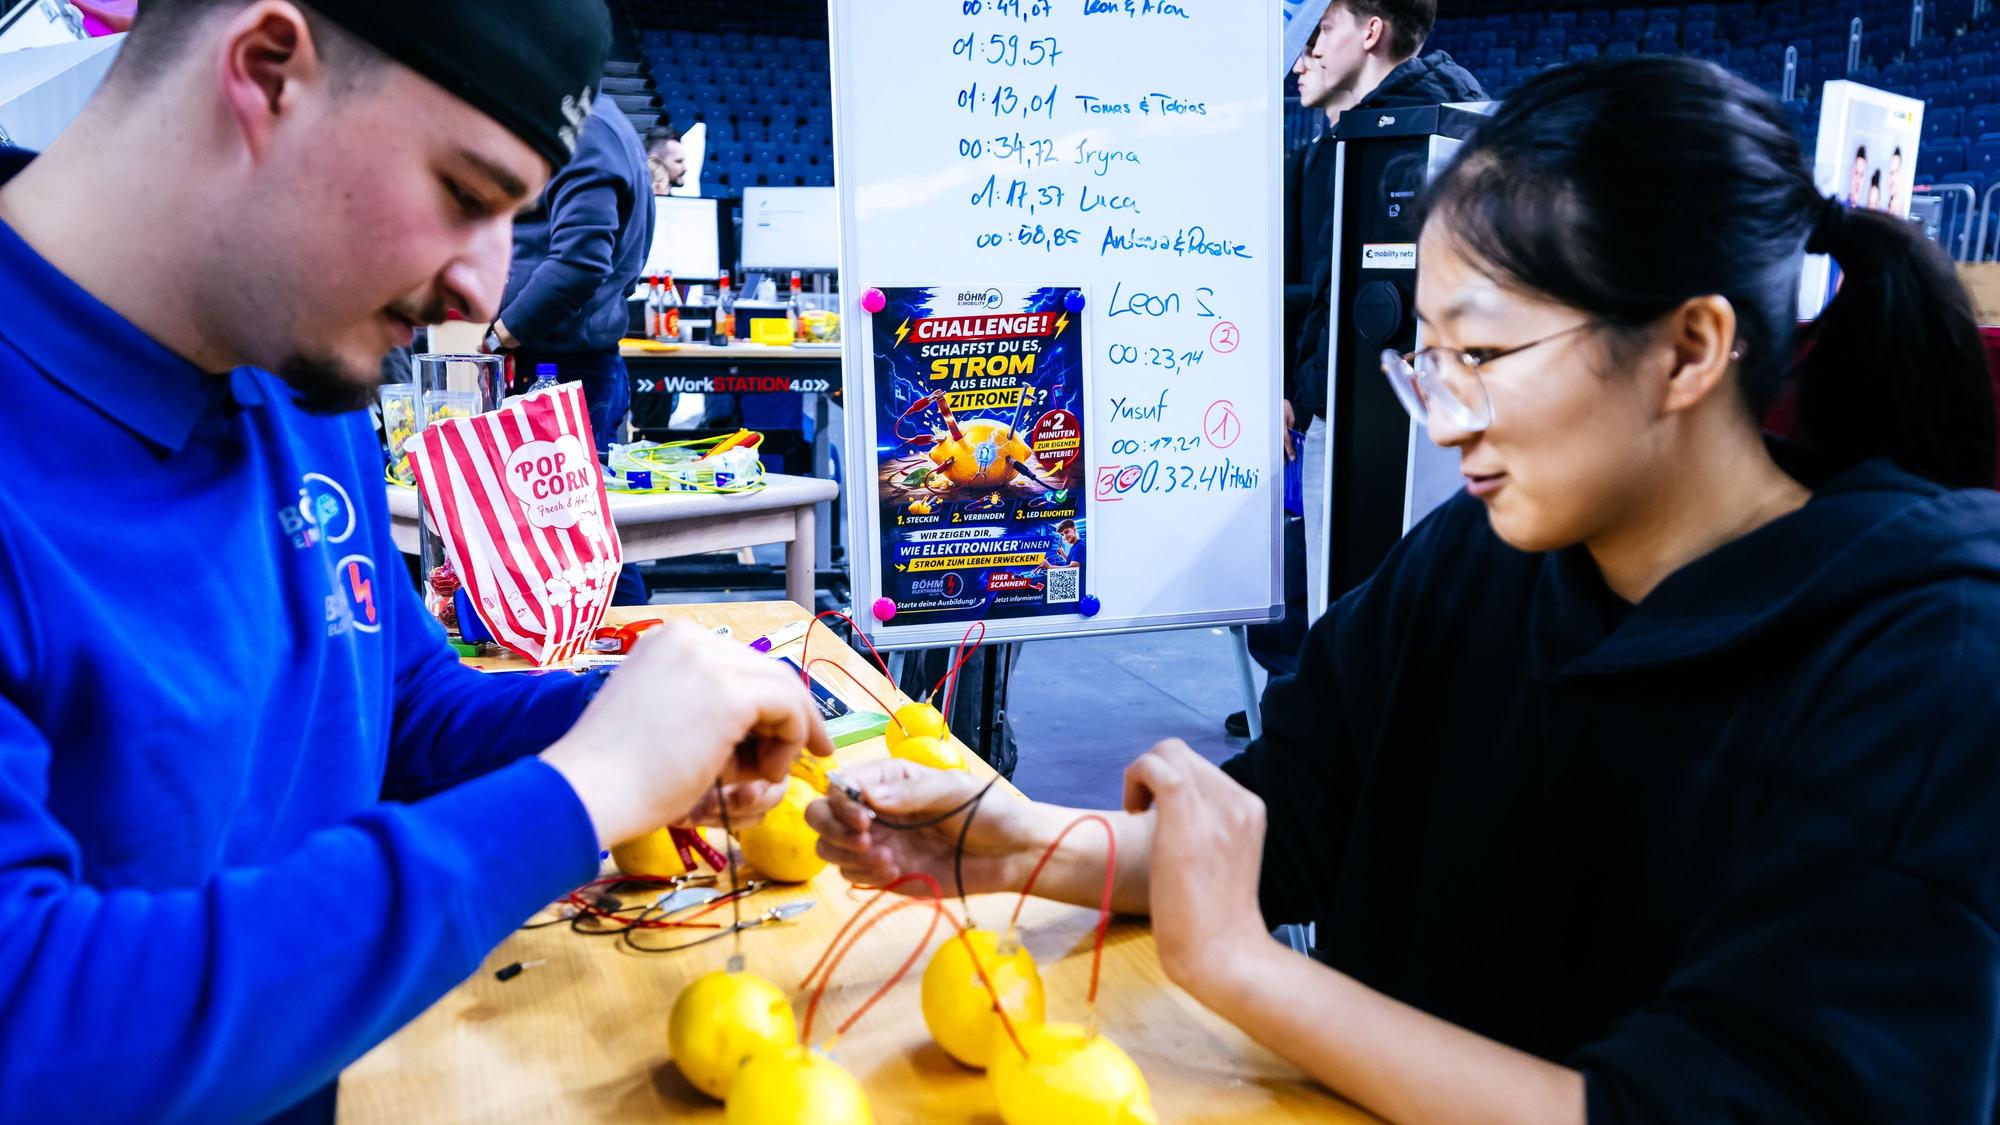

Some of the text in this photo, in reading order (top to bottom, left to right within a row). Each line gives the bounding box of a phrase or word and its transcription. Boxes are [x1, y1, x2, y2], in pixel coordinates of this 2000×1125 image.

[952, 32, 1063, 66] 01:59,57
[957, 82, 1206, 119] 01:13,01 Tomas & Tobias
[959, 132, 1058, 168] 00:34,72
[1080, 185, 1141, 213] Luca
[1373, 249, 1399, 258] mobility
[1400, 249, 1414, 257] netz
[957, 290, 987, 301] BÖHM
[1109, 281, 1223, 319] Leon S.
[918, 315, 1048, 339] CHALLENGE!
[921, 340, 1043, 357] SCHAFFST DU ES,
[1108, 343, 1204, 375] 00:23,14
[929, 354, 1036, 380] STROM
[950, 376, 1017, 390] AUS EINER
[949, 390, 1019, 409] ZITRONE
[1110, 388, 1169, 423] Yusuf
[1042, 413, 1065, 430] IN 2
[1038, 429, 1076, 440] MINUTEN
[1051, 440, 1077, 448] EIGENEN
[1039, 449, 1074, 460] BATTERIE!
[514, 452, 566, 482] POP
[532, 467, 590, 500] CORN
[537, 502, 565, 517] Fresh
[1016, 509, 1075, 519] 3. LED LEUCHTET!
[897, 515, 940, 525] 1. STECKEN
[951, 512, 1005, 523] 2. VERBINDEN
[920, 529, 992, 540] WIR ZEIGEN DIR,
[900, 546, 920, 556] WIE
[914, 554, 1040, 569] STROM ZUM LEBEN ERWECKEN!
[911, 579, 944, 590] BÖHM
[990, 580, 1027, 589] SCANNEN!
[897, 597, 977, 609] Starte deine Ausbildung!
[1010, 594, 1044, 602] informieren!
